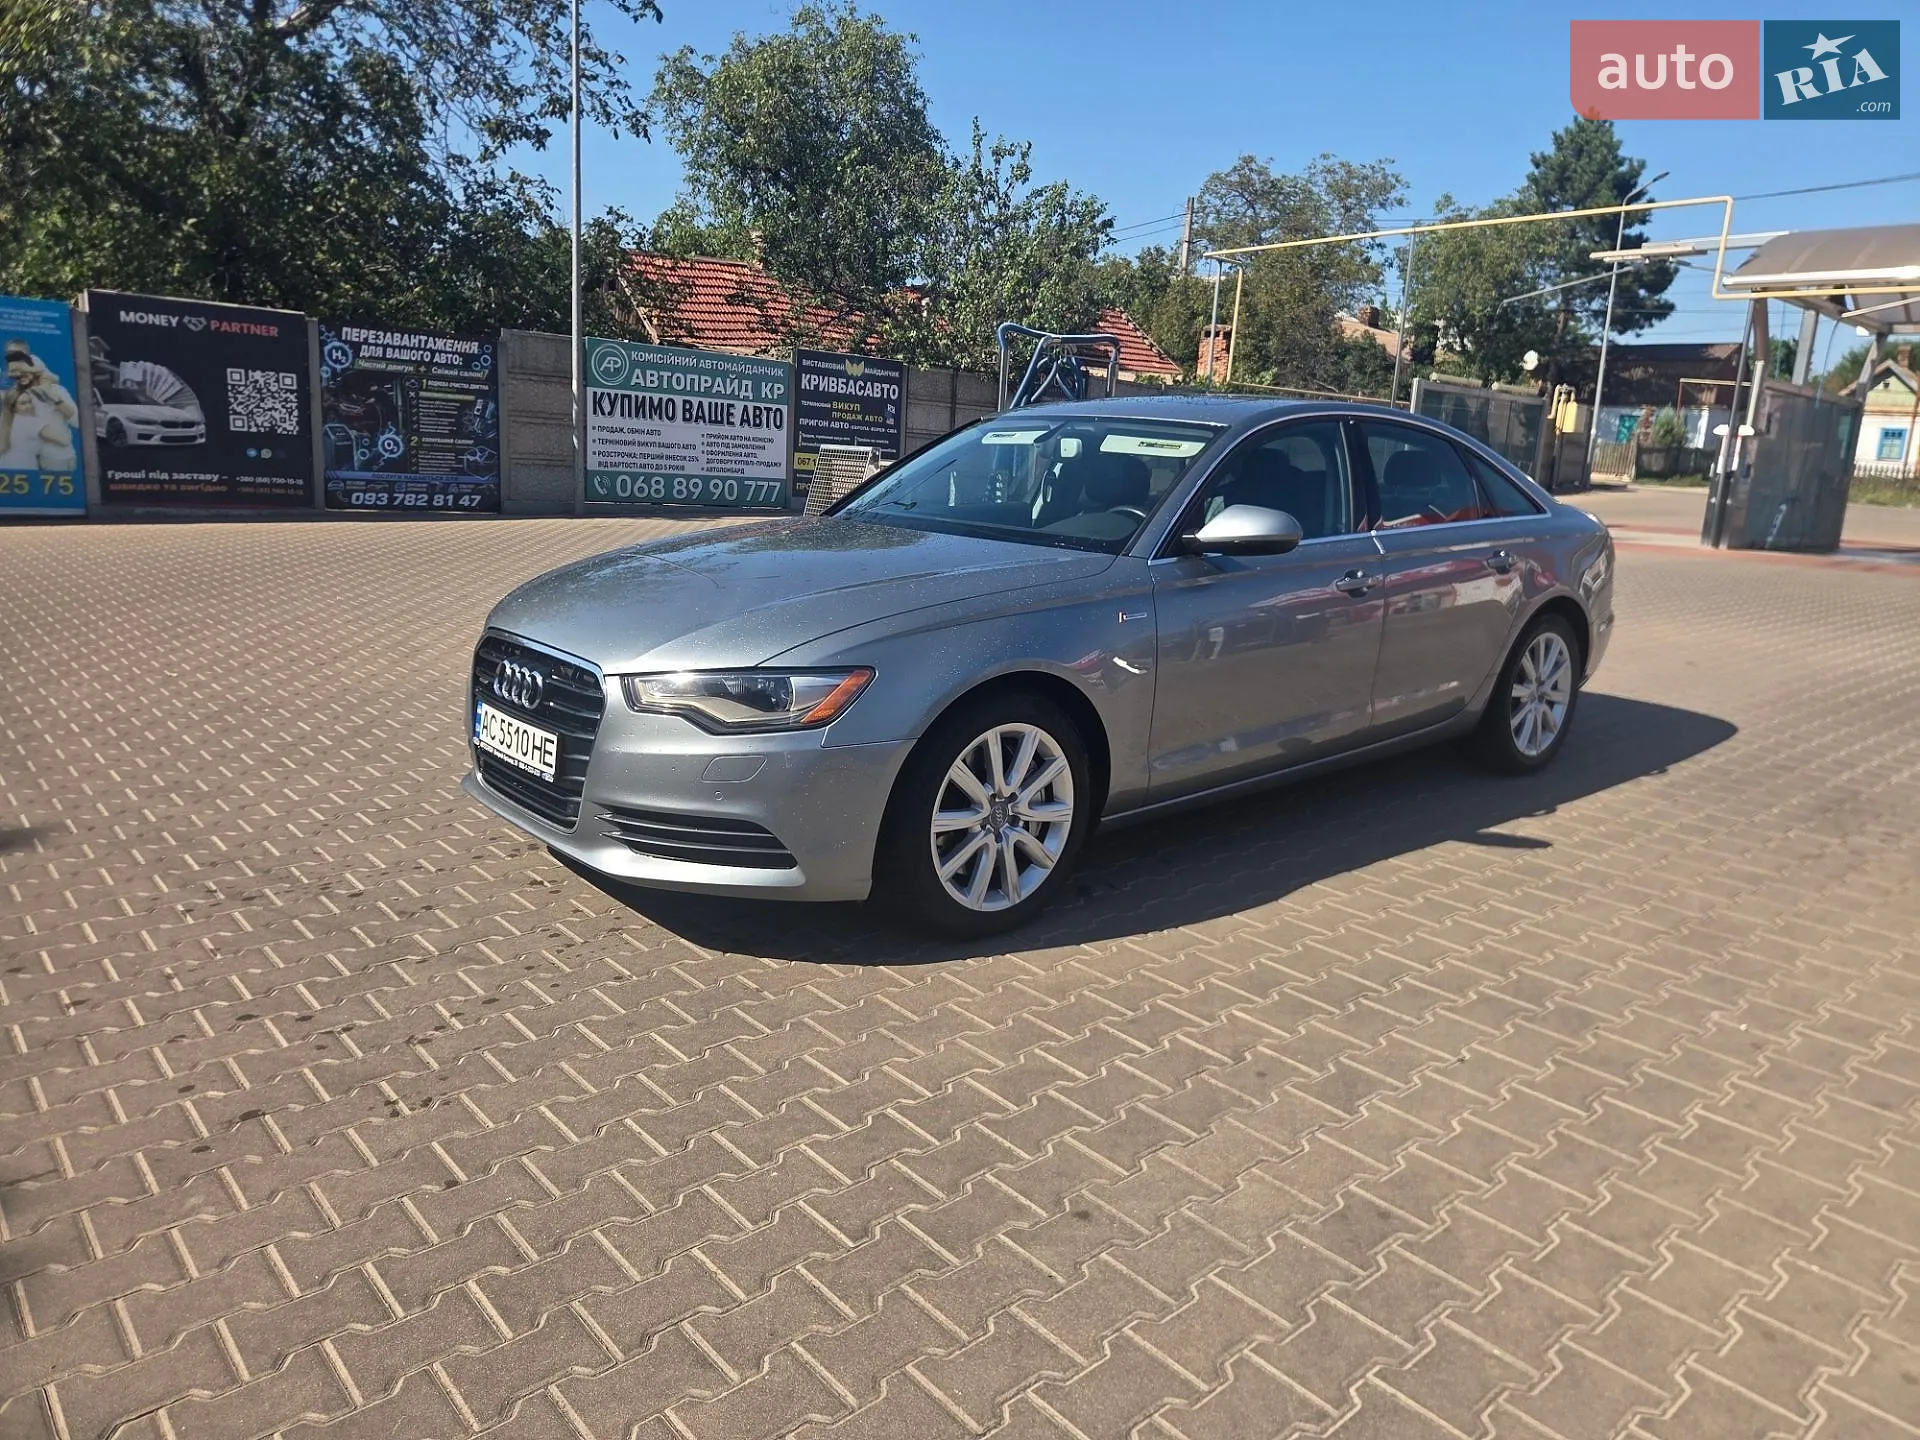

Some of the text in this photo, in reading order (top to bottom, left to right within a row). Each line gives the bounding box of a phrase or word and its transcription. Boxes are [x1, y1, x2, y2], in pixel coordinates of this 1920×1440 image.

[119, 310, 279, 337] MONEY PARTNER
[341, 326, 480, 354] ПЕРЕЗАВАНТАЖЕННЯ
[359, 345, 463, 365] ДЛЯ ВАШОГО АВТО:
[631, 351, 784, 377] КОМІСІЙНИЙ АВТОМАЙДАНЧИК
[865, 367, 900, 377] МАЙДАНЧИК
[630, 368, 785, 400] АВТОПРАЙД КР
[801, 373, 899, 400] КРИВБАСАВТО
[592, 391, 784, 431] КУПИМО ВАШЕ АВТО
[832, 401, 861, 411] ВИКУП
[831, 411, 863, 421] ПРОДАЖ
[865, 414, 883, 423] АВТО
[799, 418, 829, 427] ПРИГОН
[830, 420, 849, 429] АВТО
[410, 437, 419, 447] 2
[706, 432, 729, 441] ПРИЙОМ
[598, 438, 636, 447] ТЕРМІНОВИЙ
[637, 440, 657, 448] ВИКУП
[658, 441, 681, 449] ВАШОГО
[731, 443, 766, 451] ЗАМОВЛЕННЯ
[639, 452, 664, 460] ПЕРШИЙ
[665, 454, 687, 462] ВНЕСОК
[706, 449, 743, 458] ОФОРМЛЕННЯ
[598, 460, 609, 469] ВІД
[609, 461, 638, 470] ВАРТОСТІ
[639, 463, 654, 471] АВТО
[706, 458, 733, 466] ДОГОВОРУ
[107, 470, 145, 480] Гроші
[149, 470, 169, 480] під
[706, 466, 745, 475] АВТОЛОМБАРД
[40, 475, 75, 496] 75
[615, 474, 781, 502] 068 89 90 777
[351, 492, 481, 507] 093 782 81 47
